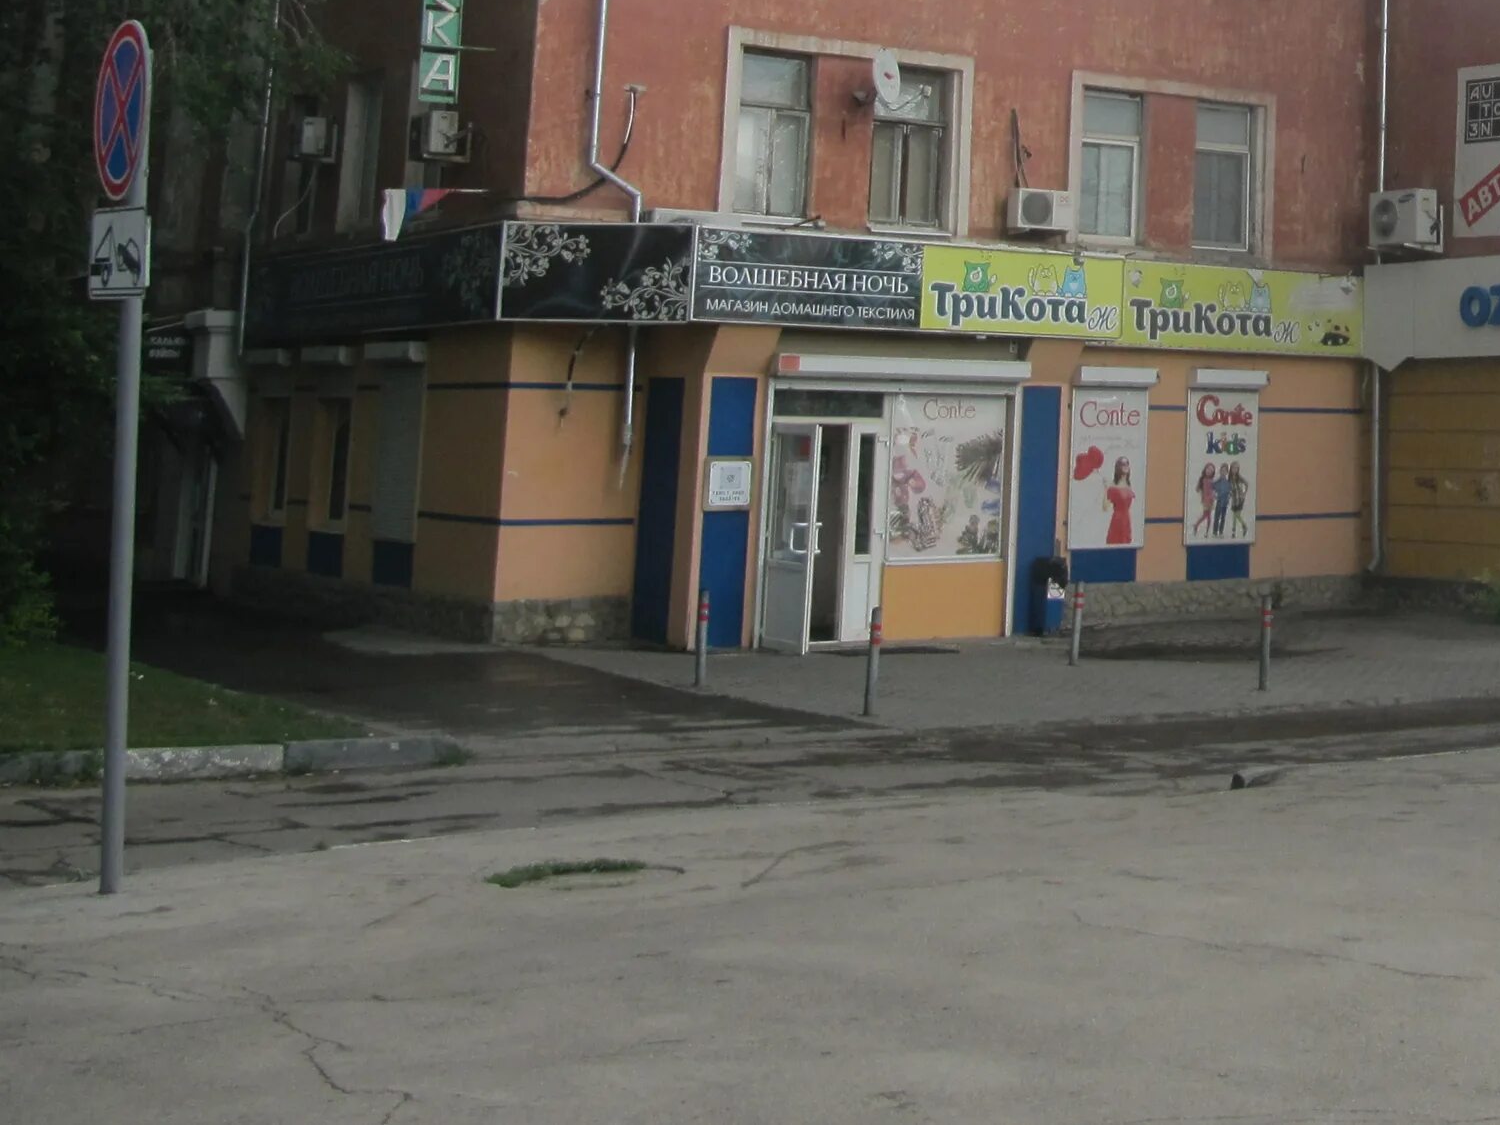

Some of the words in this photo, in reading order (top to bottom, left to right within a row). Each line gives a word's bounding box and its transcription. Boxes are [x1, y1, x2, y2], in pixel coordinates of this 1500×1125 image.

[708, 265, 846, 291] ВОЛШЕБНАЯ
[852, 274, 909, 294] НОЧЬ
[706, 298, 768, 313] МАГАЗИН
[770, 301, 854, 317] ДОМАШНЕГО
[856, 305, 915, 320] ТЕКСТИЛЯ
[922, 398, 976, 421] Conte
[1079, 400, 1141, 427] Conte
[1196, 394, 1253, 427] Conte
[1206, 431, 1247, 455] kids
